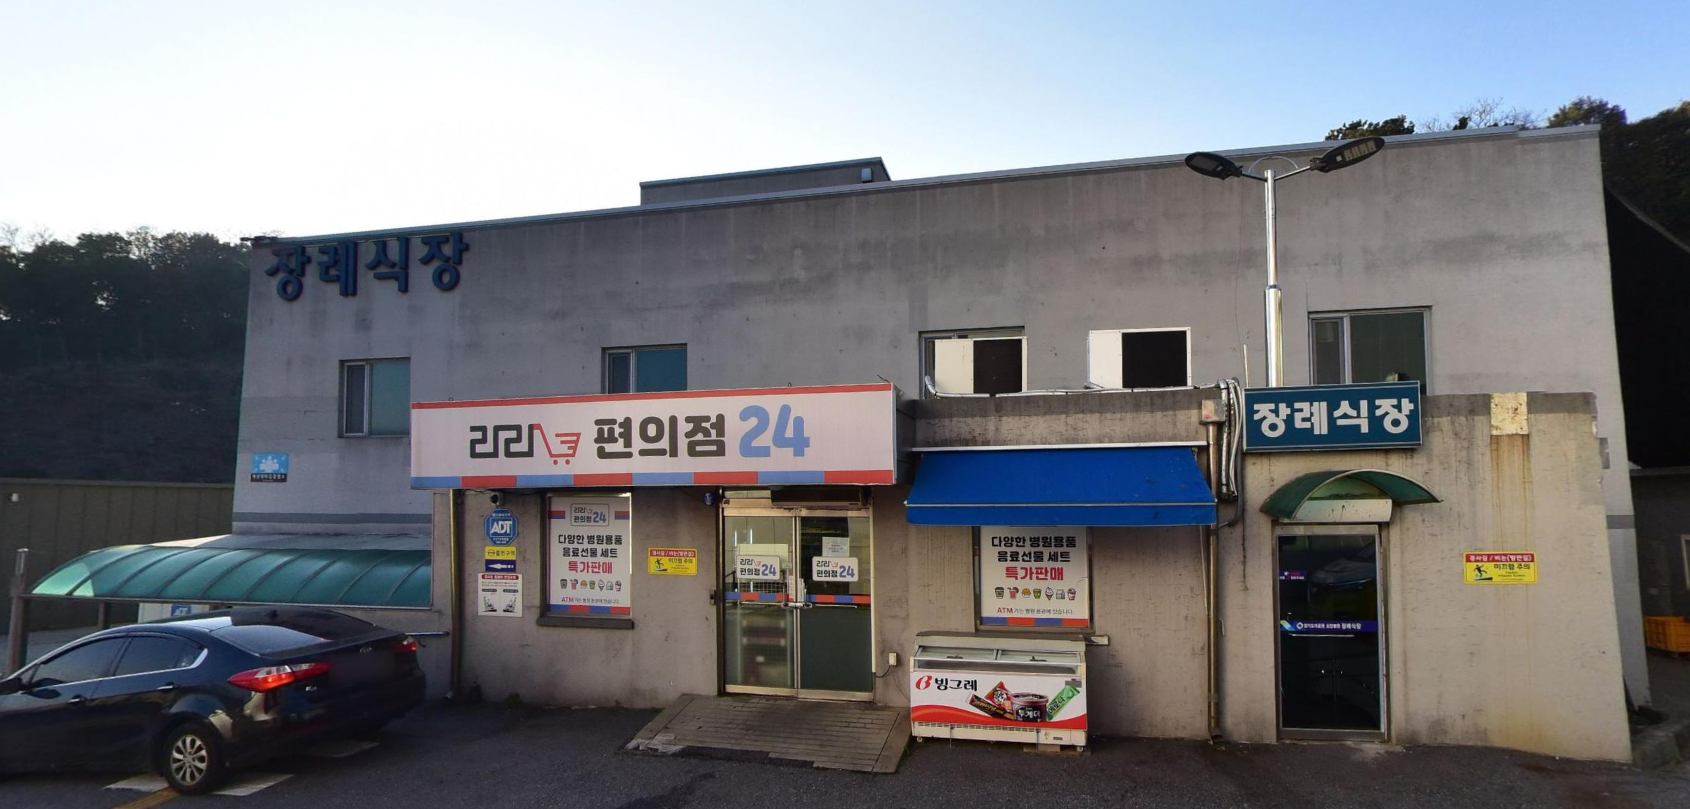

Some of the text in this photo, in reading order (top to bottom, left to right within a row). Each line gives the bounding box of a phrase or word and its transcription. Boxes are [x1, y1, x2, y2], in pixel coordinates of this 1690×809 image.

[264, 232, 470, 301] 장례식장
[1253, 398, 1414, 438] 장례식장
[594, 413, 726, 460] 편의점
[739, 404, 811, 457] 24
[574, 511, 606, 523] 편의점 24
[490, 521, 512, 534] ADT
[558, 534, 622, 545] 다양한 병원용품
[991, 536, 1077, 548] 다양한 병원용품
[563, 547, 618, 558] 음료선물 세트
[997, 551, 1071, 562] 음료선물 세트
[568, 561, 612, 574] 특가판매
[740, 564, 777, 576] 편의점 24
[816, 565, 855, 578] 편의점 24
[1005, 566, 1064, 581] 특가판매
[935, 678, 977, 691] 빙그레
